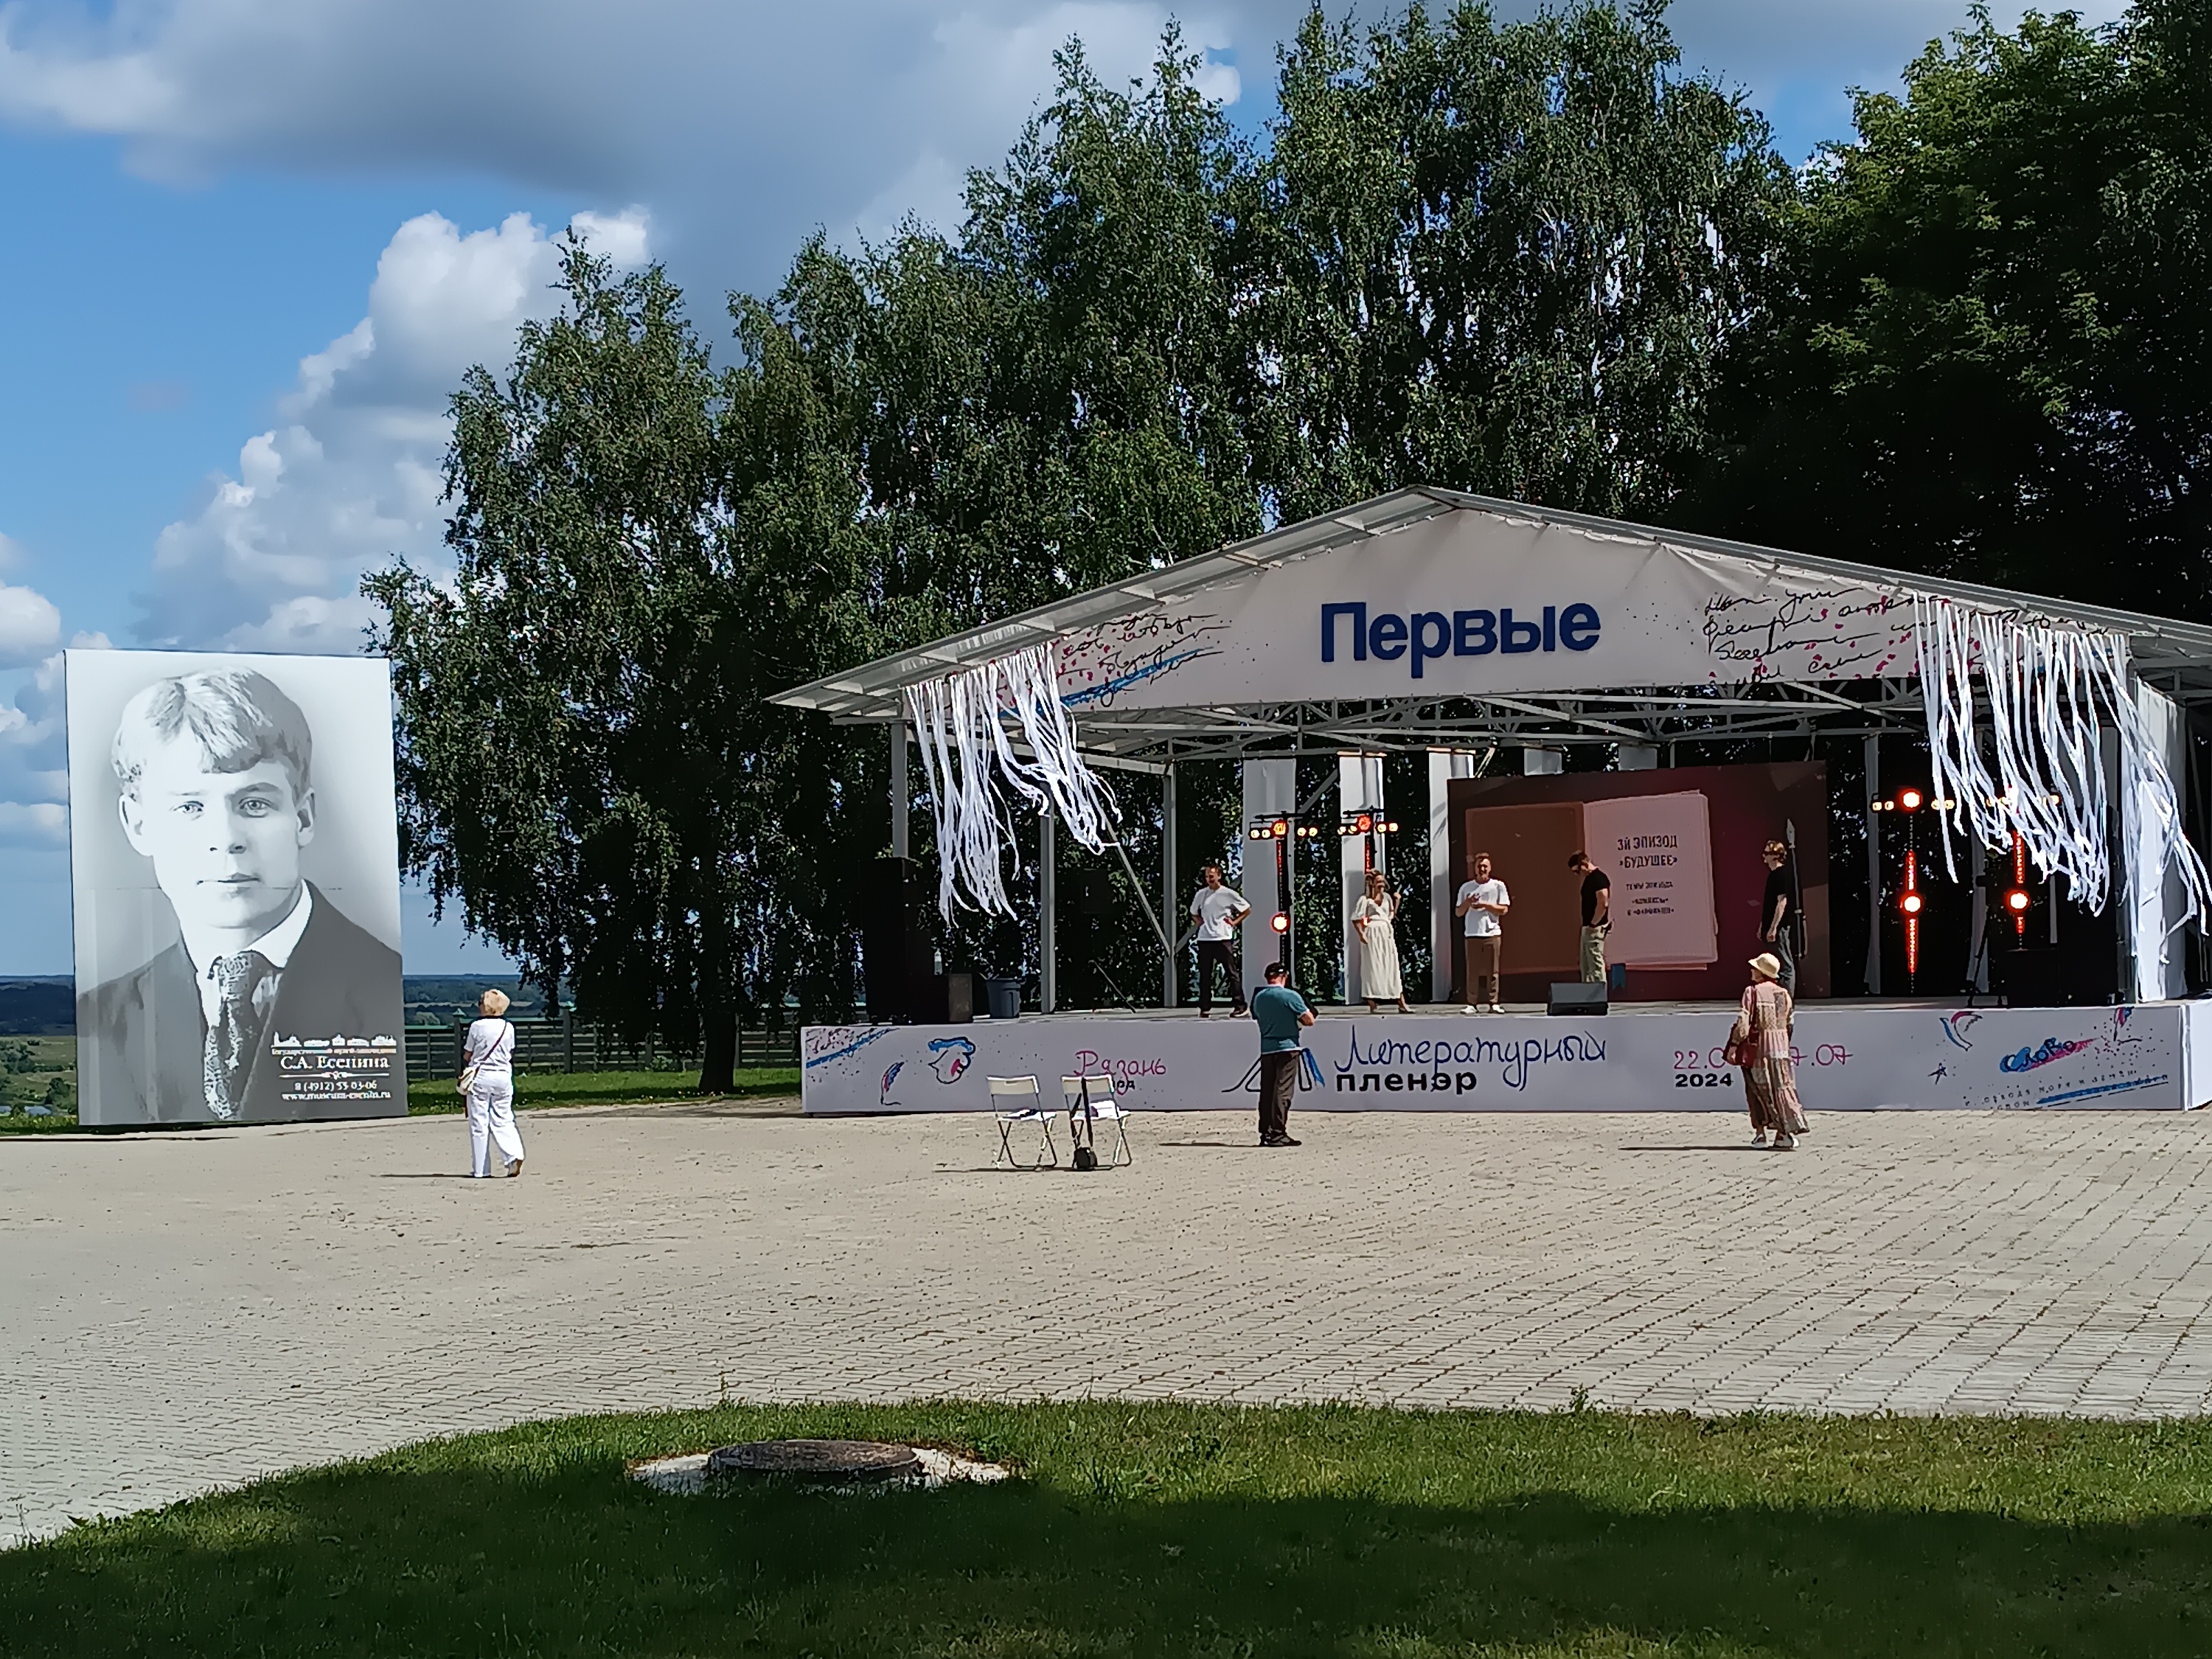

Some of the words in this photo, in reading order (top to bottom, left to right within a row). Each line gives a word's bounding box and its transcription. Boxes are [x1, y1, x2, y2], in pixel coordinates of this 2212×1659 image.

[1321, 602, 1601, 678] Первые
[1633, 835, 1677, 849] ЭПИЗОД
[1074, 1050, 1166, 1096] Рязань
[1334, 1024, 1606, 1091] Литературный
[1335, 1071, 1477, 1095] пленэр
[1675, 1073, 1732, 1088] 2024
